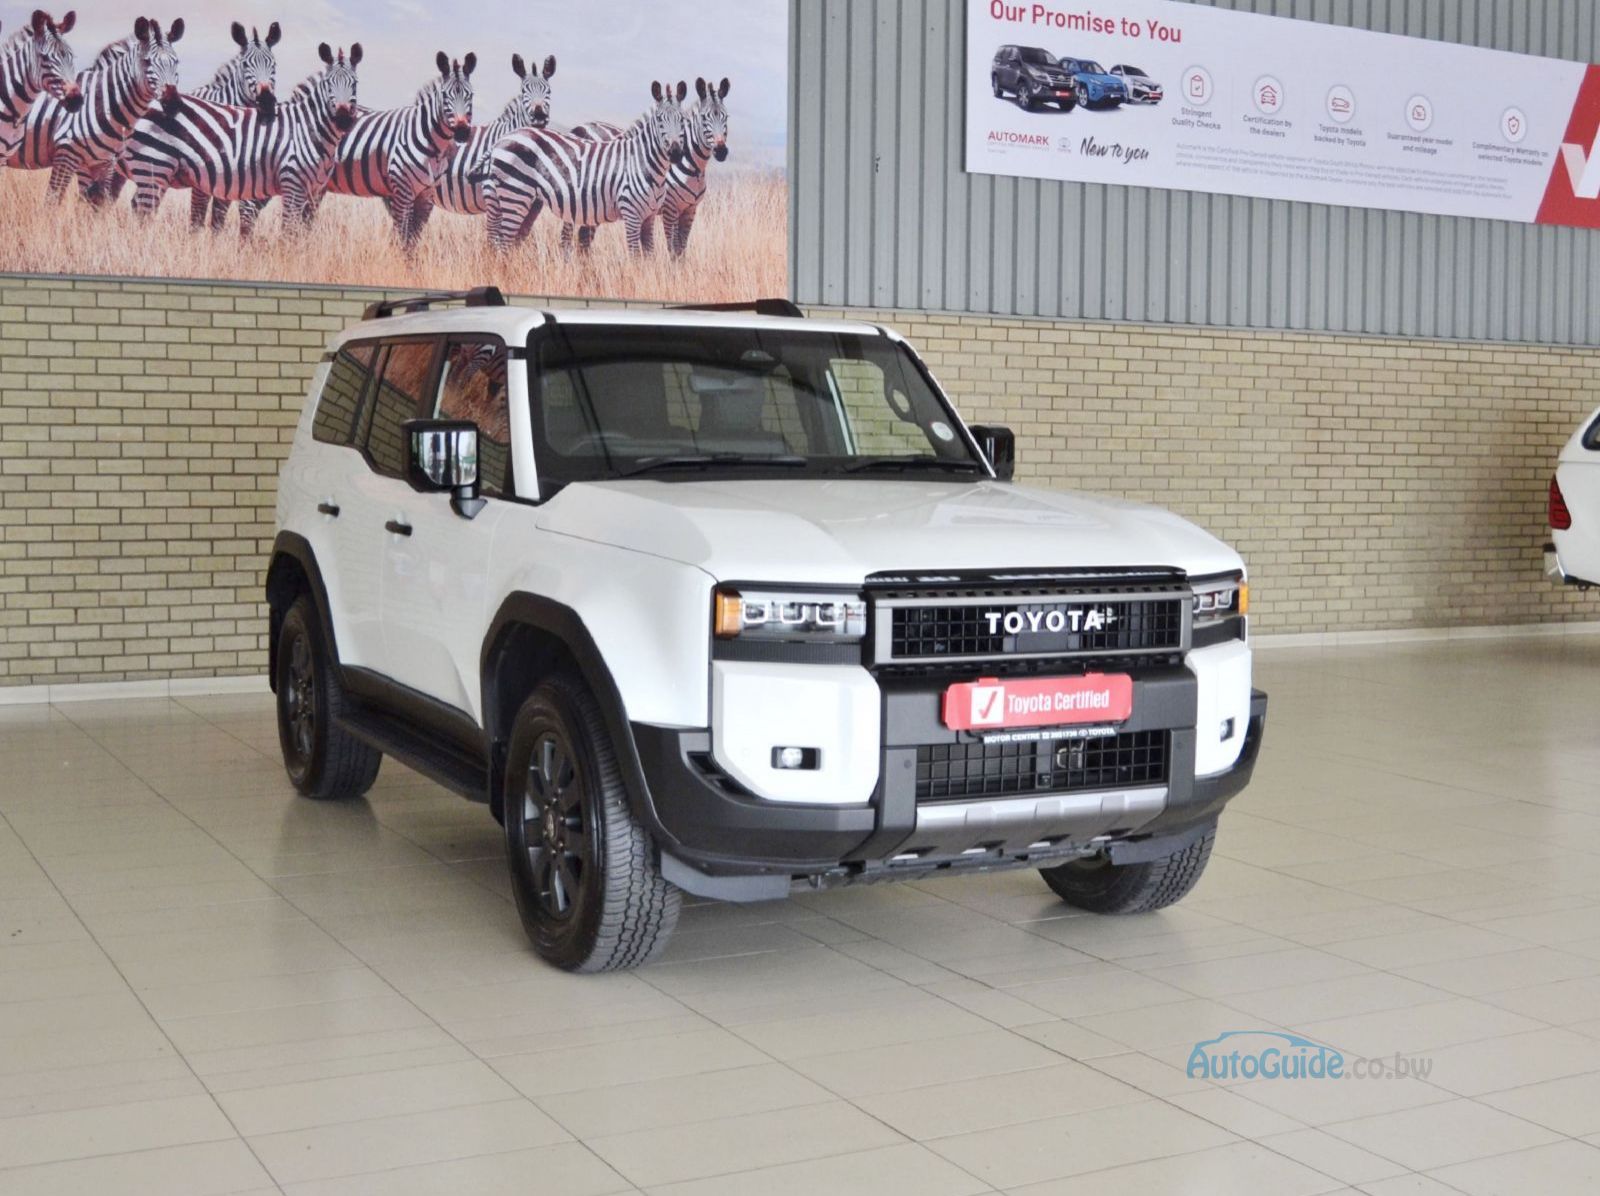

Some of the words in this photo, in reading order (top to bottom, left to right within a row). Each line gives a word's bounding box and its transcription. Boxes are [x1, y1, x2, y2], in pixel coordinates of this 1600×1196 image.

[990, 0, 1026, 22] Our
[1032, 4, 1115, 34] Promise
[1121, 16, 1141, 37] to
[1147, 20, 1181, 43] You
[1171, 117, 1195, 128] Quality
[1196, 120, 1221, 131] Checks
[1243, 114, 1283, 127] Certification
[1283, 120, 1292, 128] by
[1250, 127, 1261, 135] the
[1262, 128, 1285, 138] dealers
[1319, 123, 1342, 135] Toyota
[988, 131, 1049, 145] AUTOMARK
[1346, 137, 1366, 148] Toyota
[1080, 136, 1108, 156] New
[1124, 148, 1149, 165] you
[985, 609, 1102, 635] TOYOTA
[1007, 693, 1051, 713] Toyota
[1054, 689, 1110, 710] Certified
[983, 735, 1010, 744] MOTOR
[1011, 732, 1041, 742] CENTRE
[1088, 727, 1116, 737] TOYOTA
